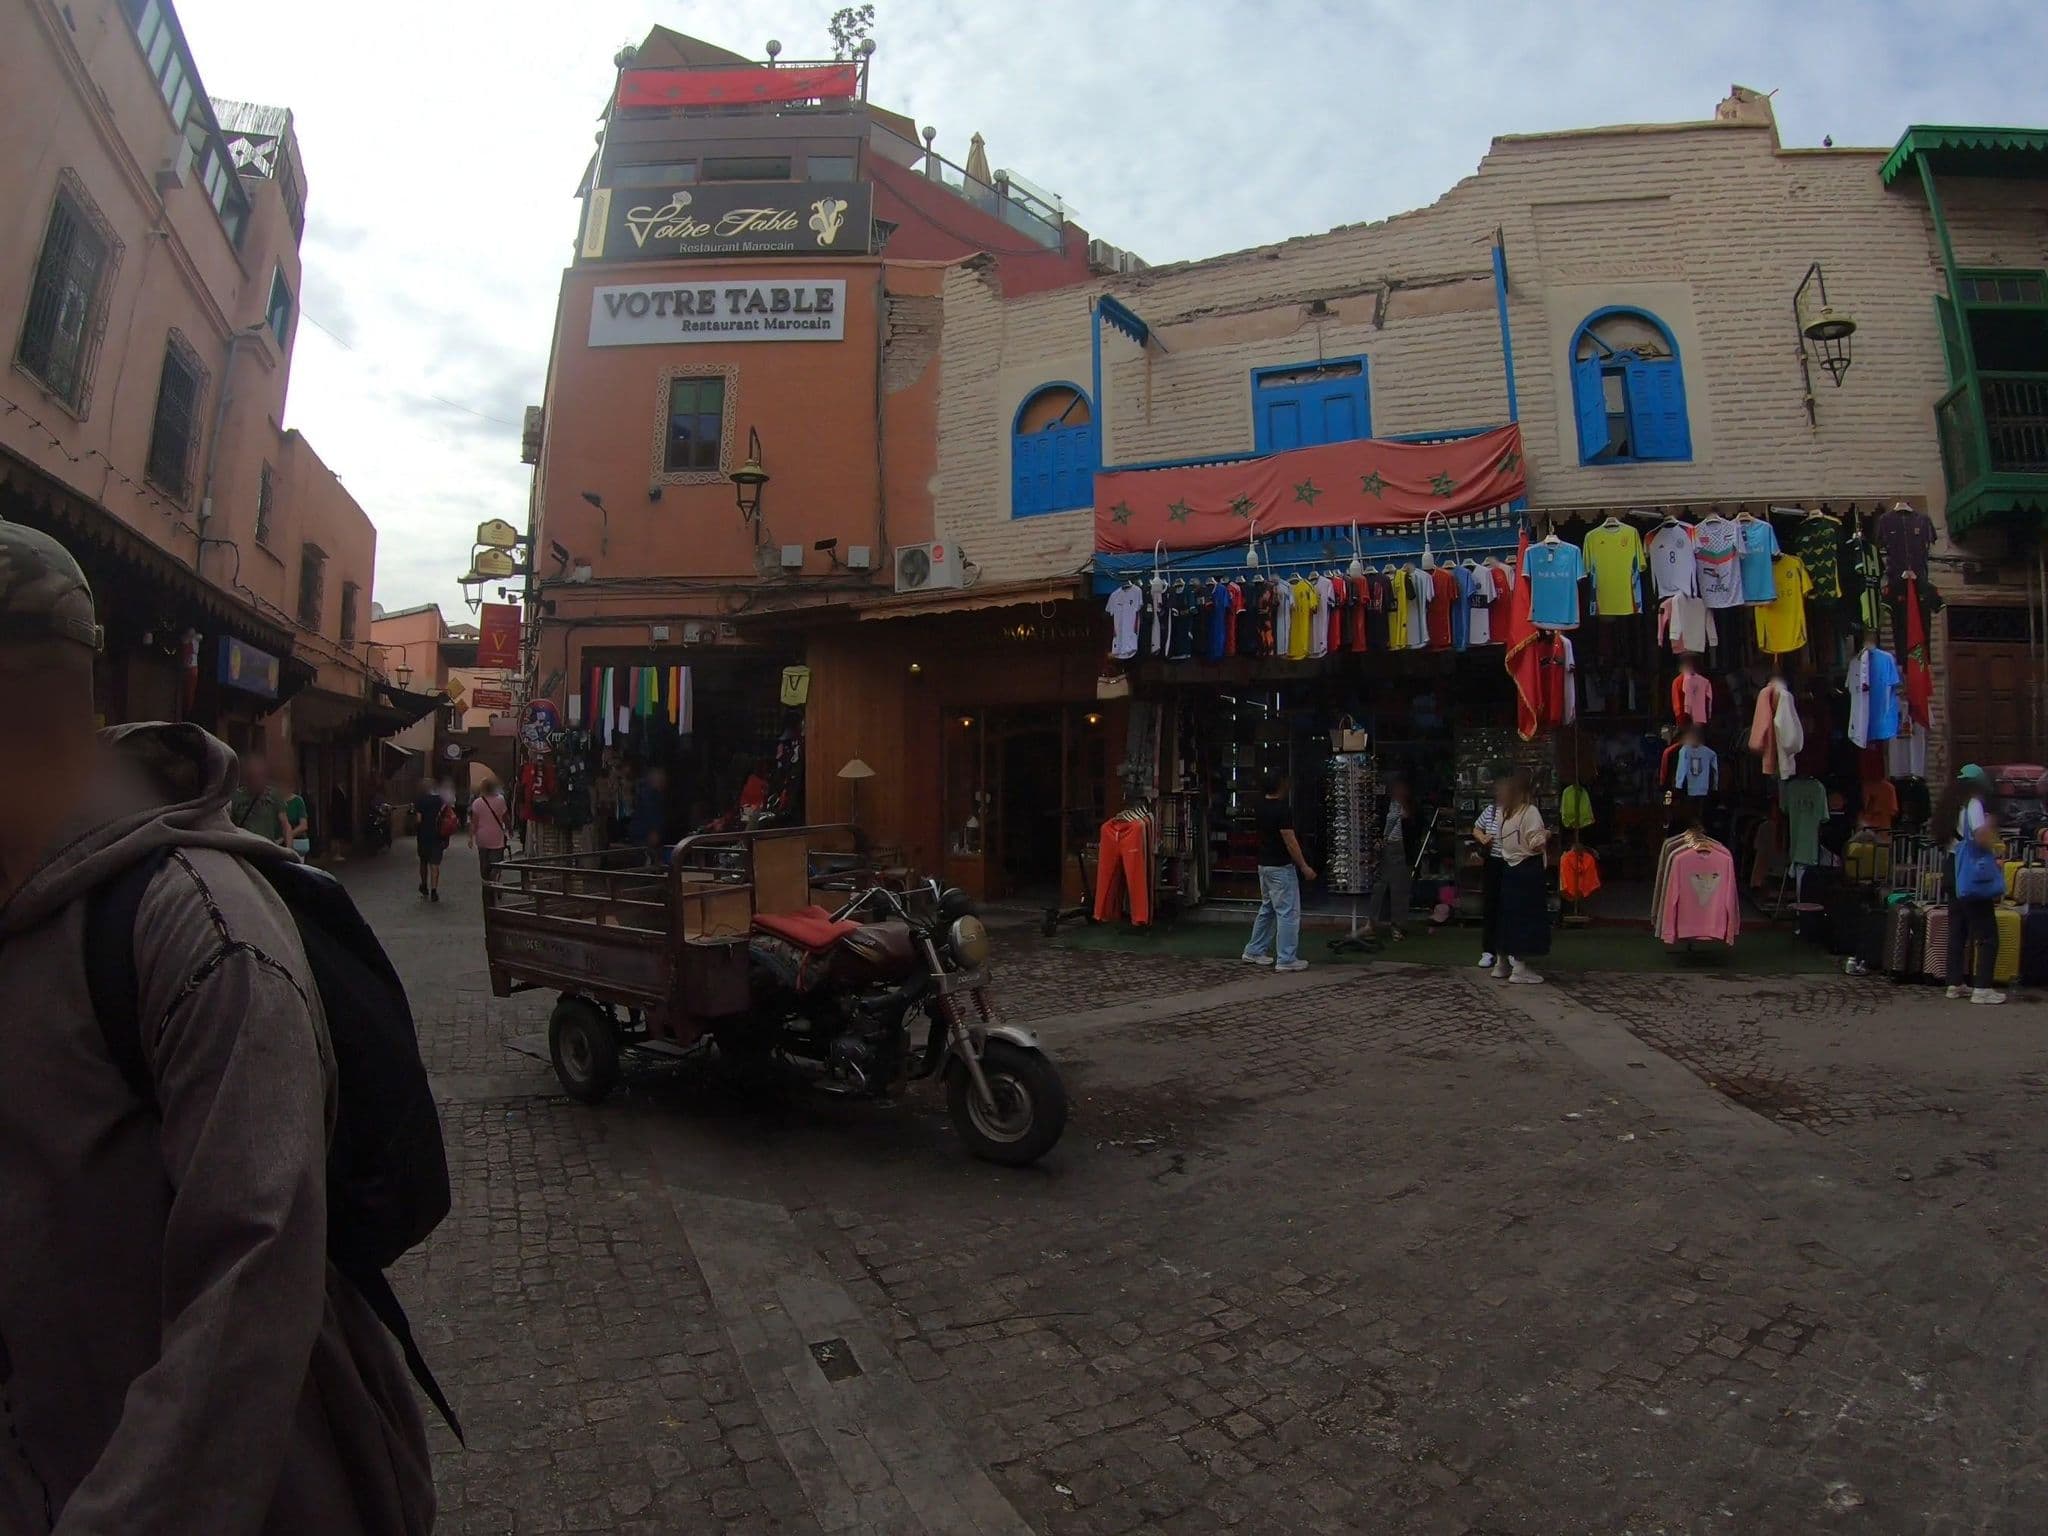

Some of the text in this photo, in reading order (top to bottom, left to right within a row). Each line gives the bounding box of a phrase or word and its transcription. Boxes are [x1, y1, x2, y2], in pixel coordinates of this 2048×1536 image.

[624, 203, 711, 249] Votre
[714, 207, 799, 237] Table
[679, 241, 795, 254] Restaurant Marocain
[603, 288, 834, 318] VOTRE TABLE
[681, 316, 831, 332] Restaurant Marocain
[1669, 551, 1676, 564] 8
